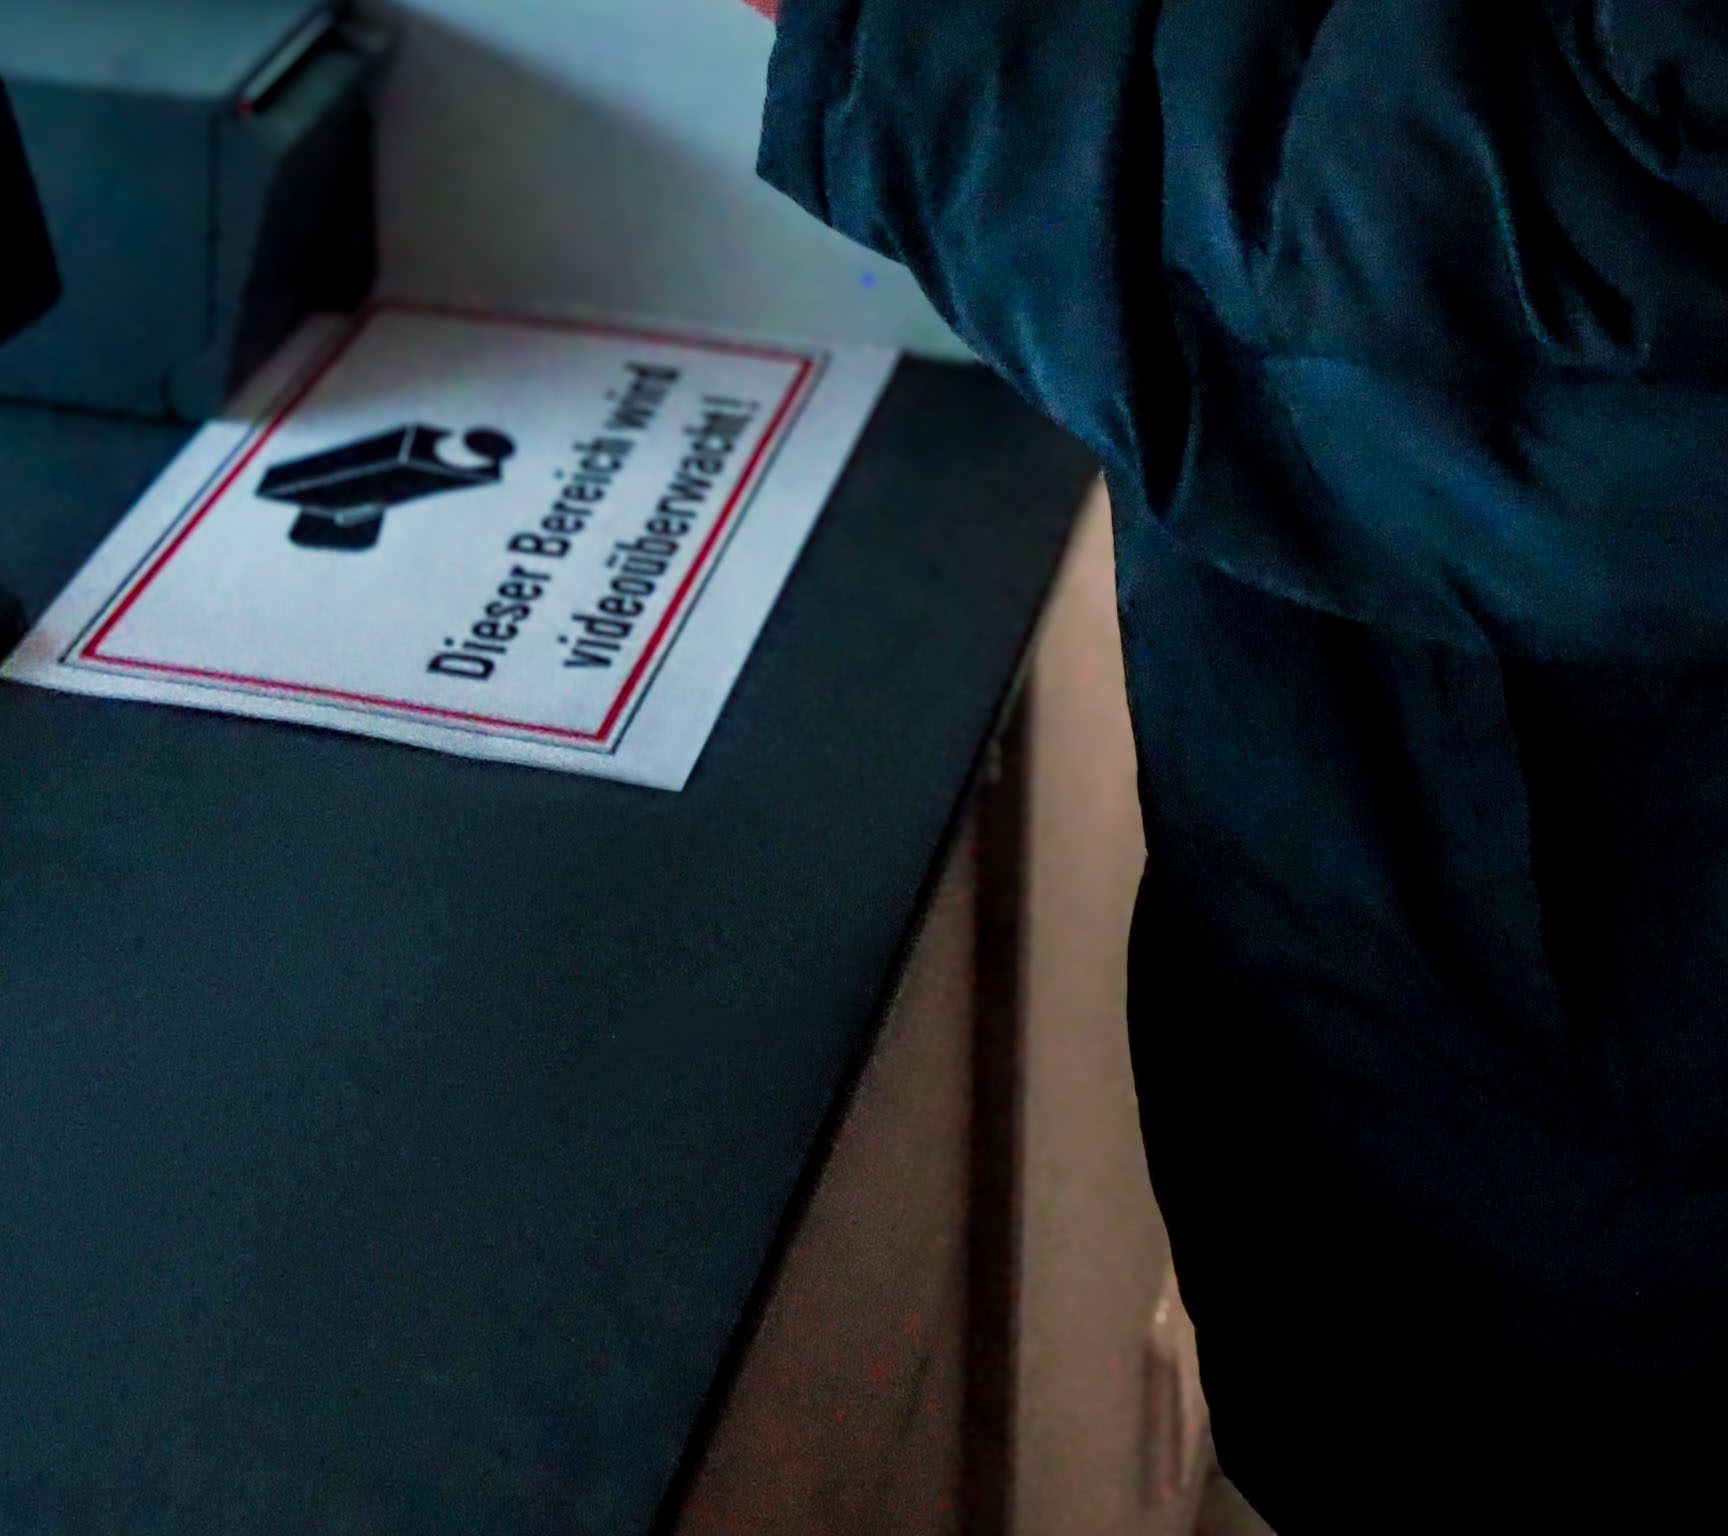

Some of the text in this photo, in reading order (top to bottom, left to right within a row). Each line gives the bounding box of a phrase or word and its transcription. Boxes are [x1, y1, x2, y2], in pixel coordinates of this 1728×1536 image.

[427, 362, 681, 681] Dieser Bereich wird
[557, 394, 761, 669] videoüberwacht!
